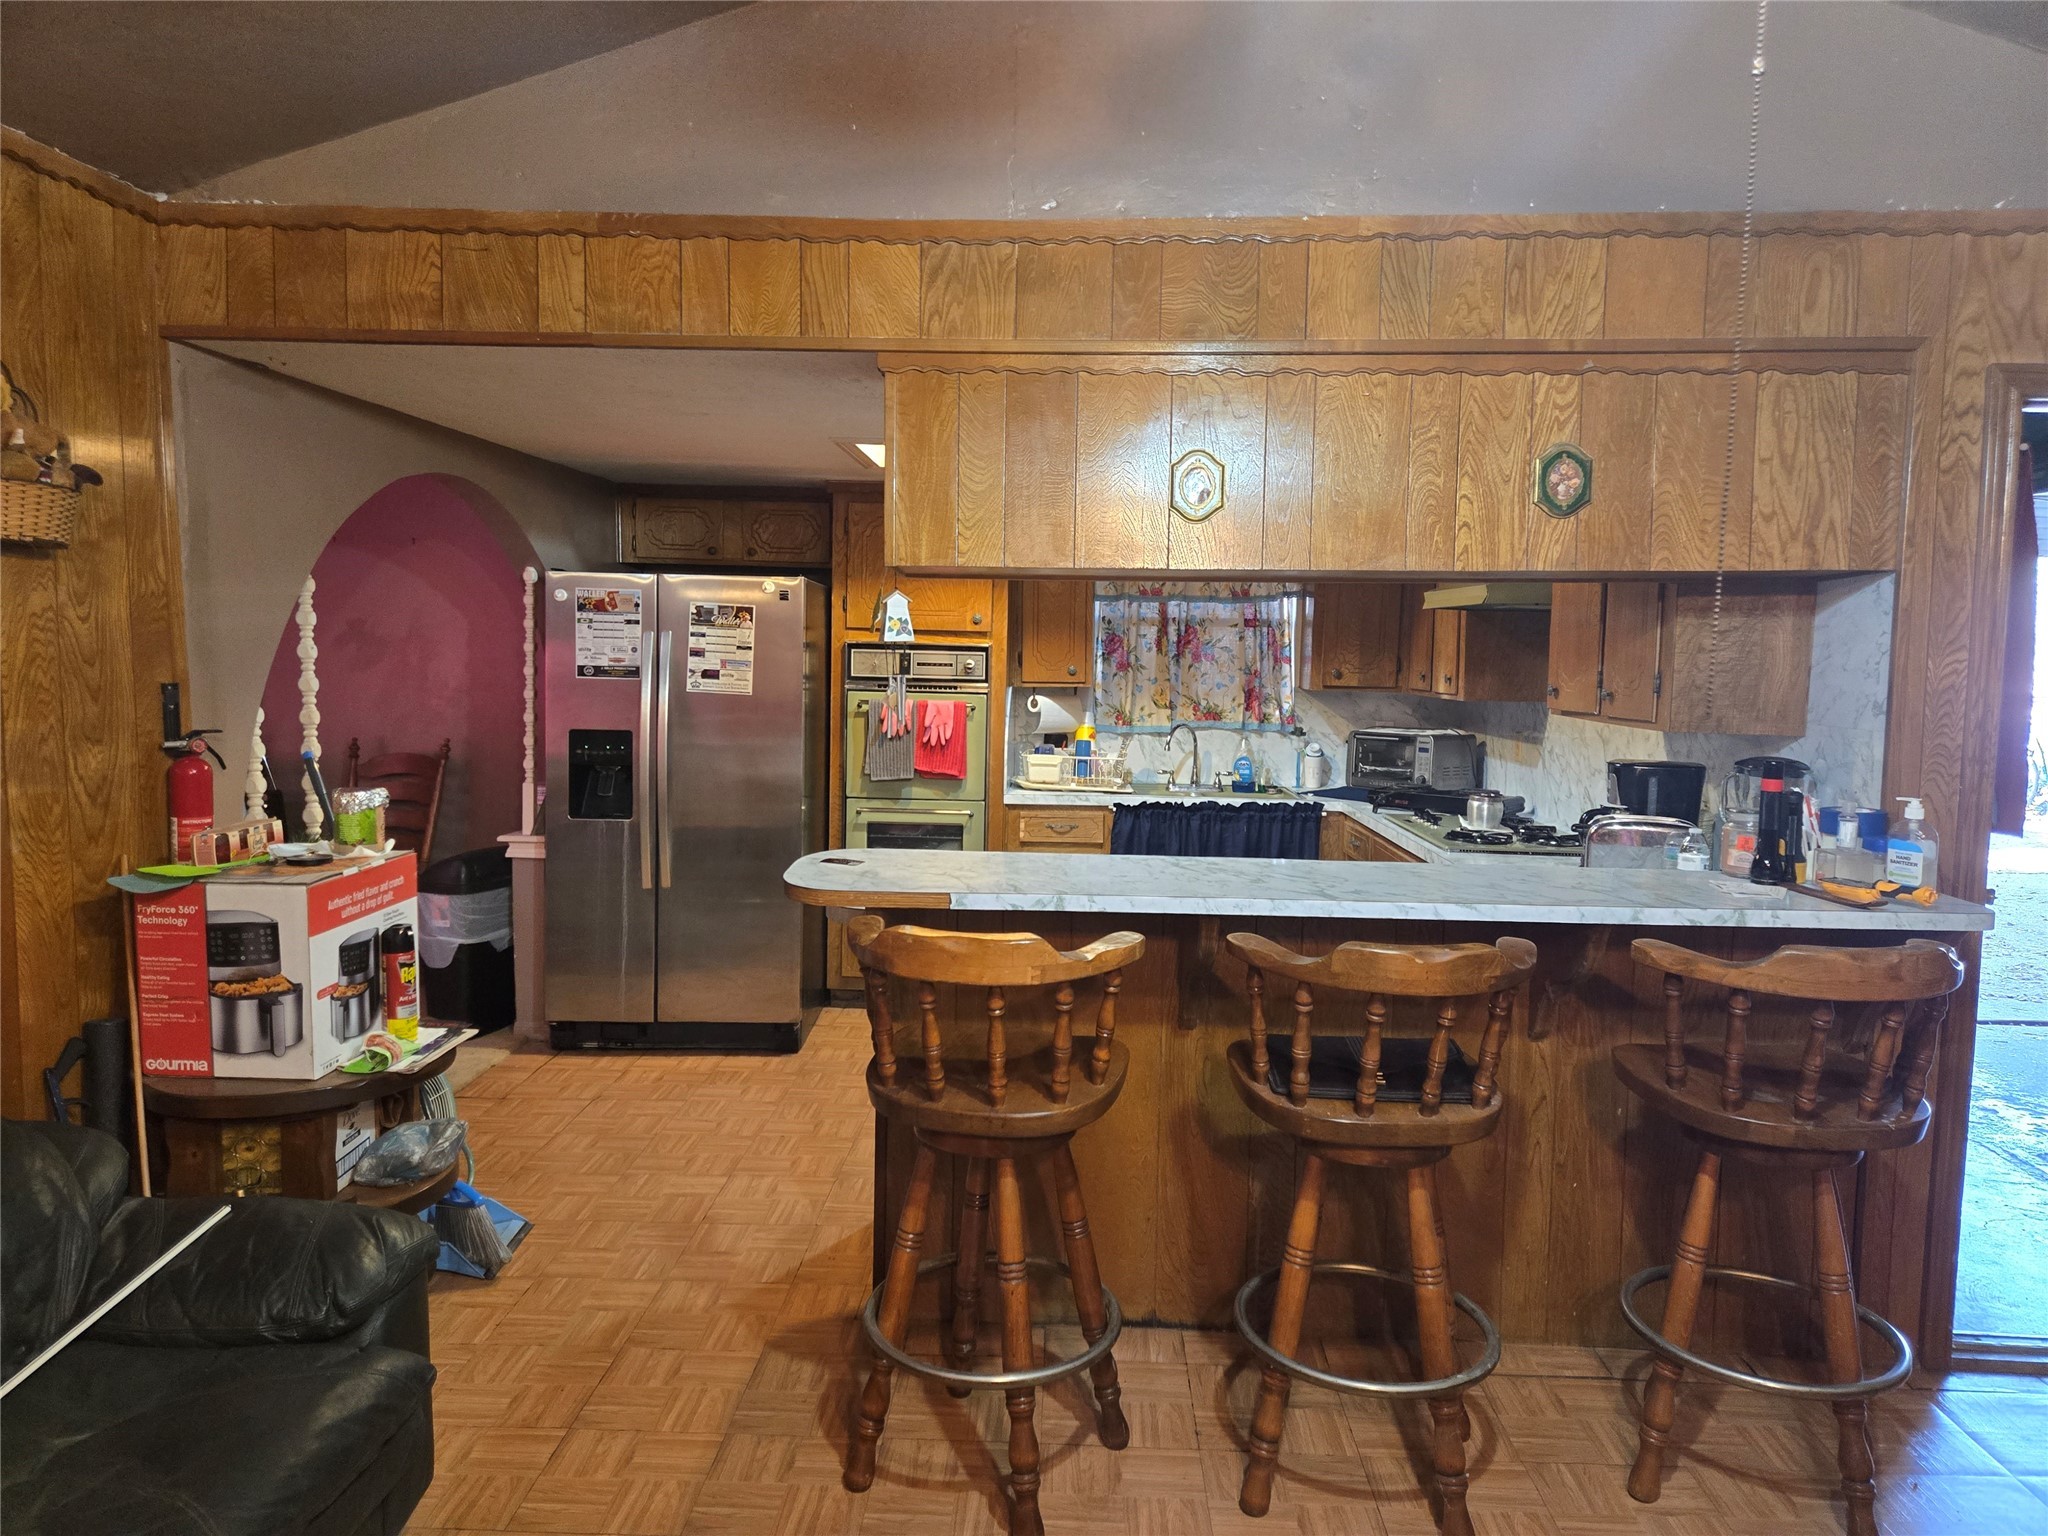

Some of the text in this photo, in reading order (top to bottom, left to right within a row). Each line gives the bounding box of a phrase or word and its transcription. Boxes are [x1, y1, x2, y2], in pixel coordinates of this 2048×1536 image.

[577, 589, 607, 598] WALLER
[1890, 859, 1919, 867] SANITIZER
[328, 875, 404, 911] Authentic fried flavor and crunch
[137, 904, 177, 915] FryForce
[341, 903, 361, 919] without
[361, 902, 366, 911] a
[365, 897, 377, 909] drop
[377, 893, 383, 905] of
[137, 915, 188, 927] Technology
